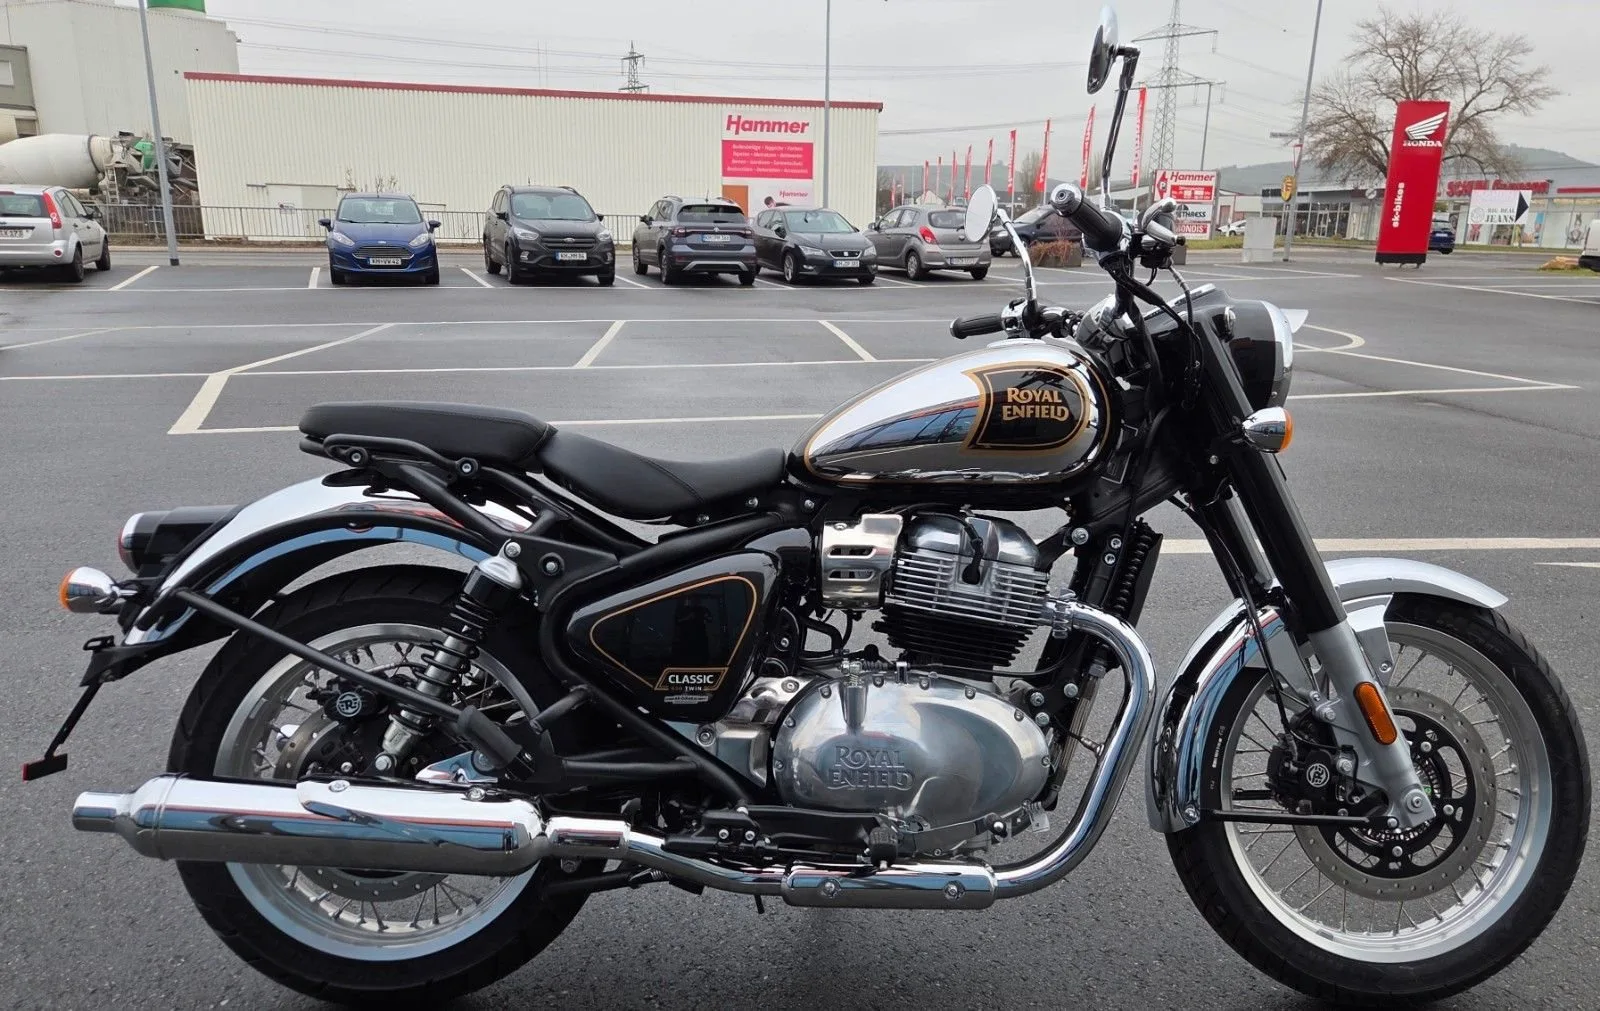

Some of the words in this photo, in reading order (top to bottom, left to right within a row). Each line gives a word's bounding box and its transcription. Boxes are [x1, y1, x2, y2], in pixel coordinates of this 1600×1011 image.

[726, 115, 809, 135] Hammer
[1170, 171, 1215, 182] Hammer
[779, 190, 808, 198] Hammer
[1391, 182, 1405, 228] sk-bikes
[1485, 214, 1515, 222] JEANS
[1007, 387, 1062, 403] ROYAL
[1002, 405, 1069, 421] ENFIELD
[668, 674, 714, 684] CLASSIC
[834, 745, 905, 769] ROYAL
[827, 769, 915, 791] ENFIELD
